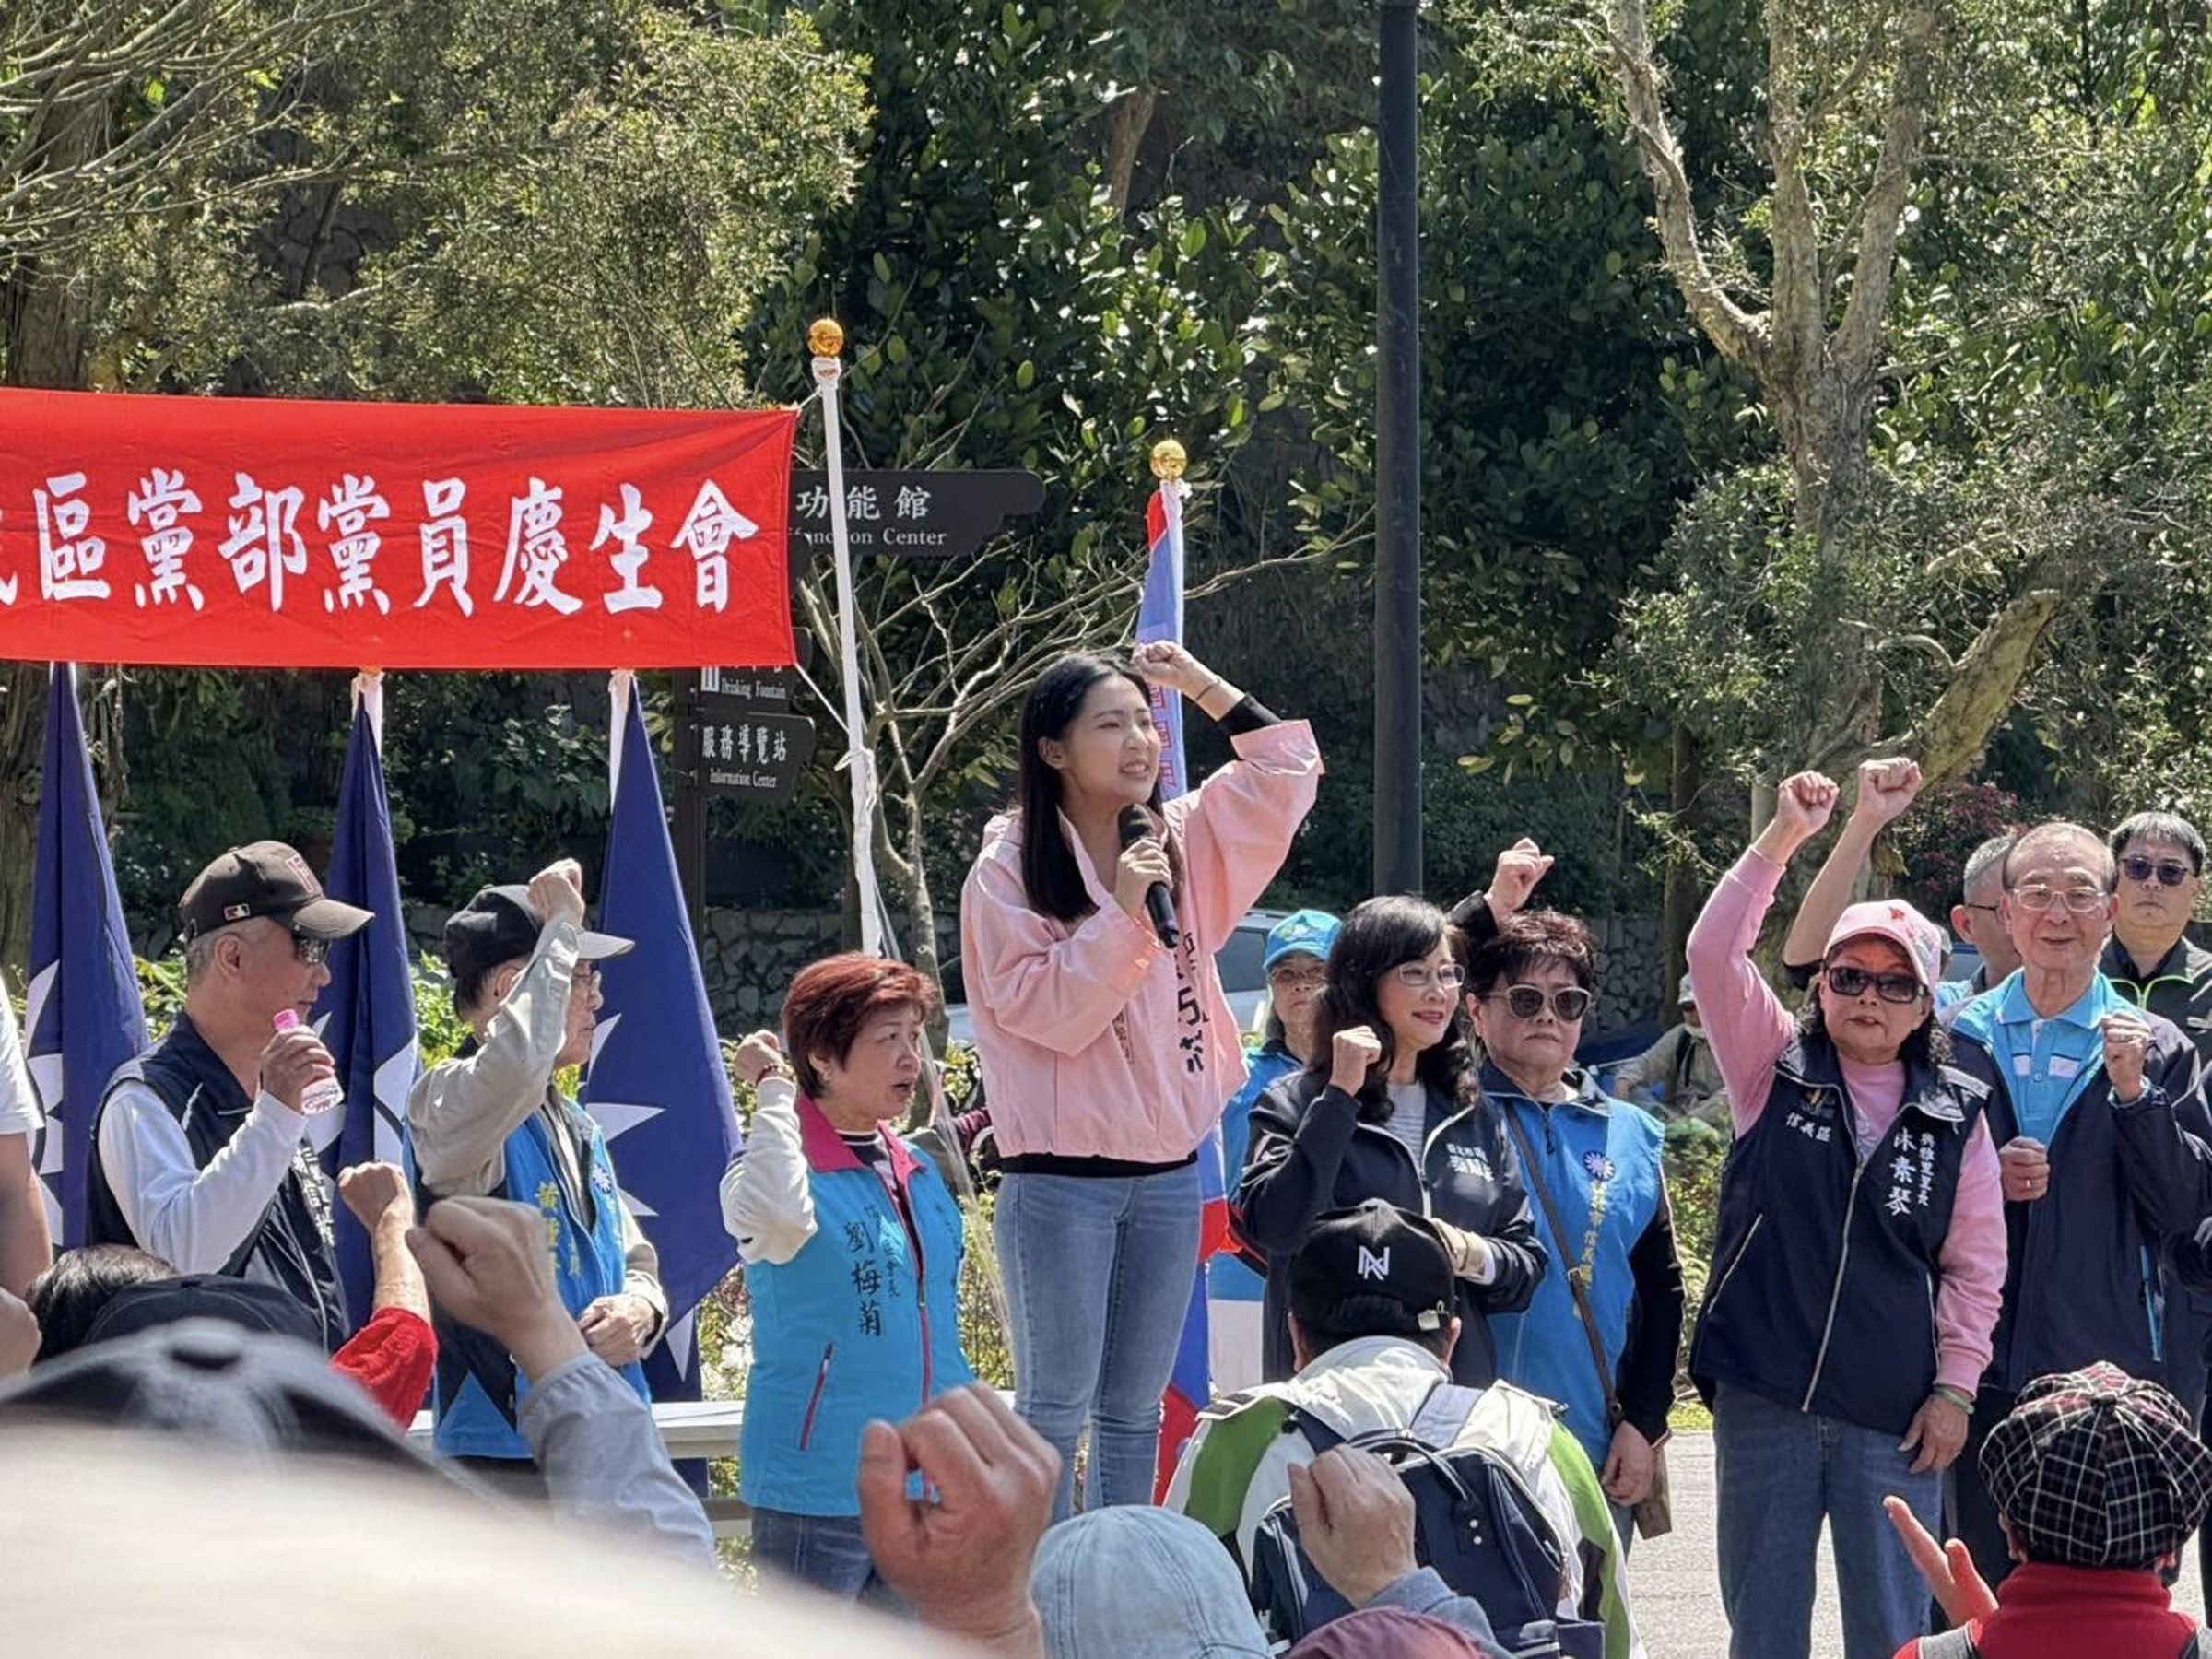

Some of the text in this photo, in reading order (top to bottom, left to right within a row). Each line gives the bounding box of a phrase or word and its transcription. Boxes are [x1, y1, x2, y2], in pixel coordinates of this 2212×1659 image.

[0, 467, 759, 617] 區黨部黨員慶生會
[882, 527, 947, 546] Center
[710, 767, 777, 788] Information Center
